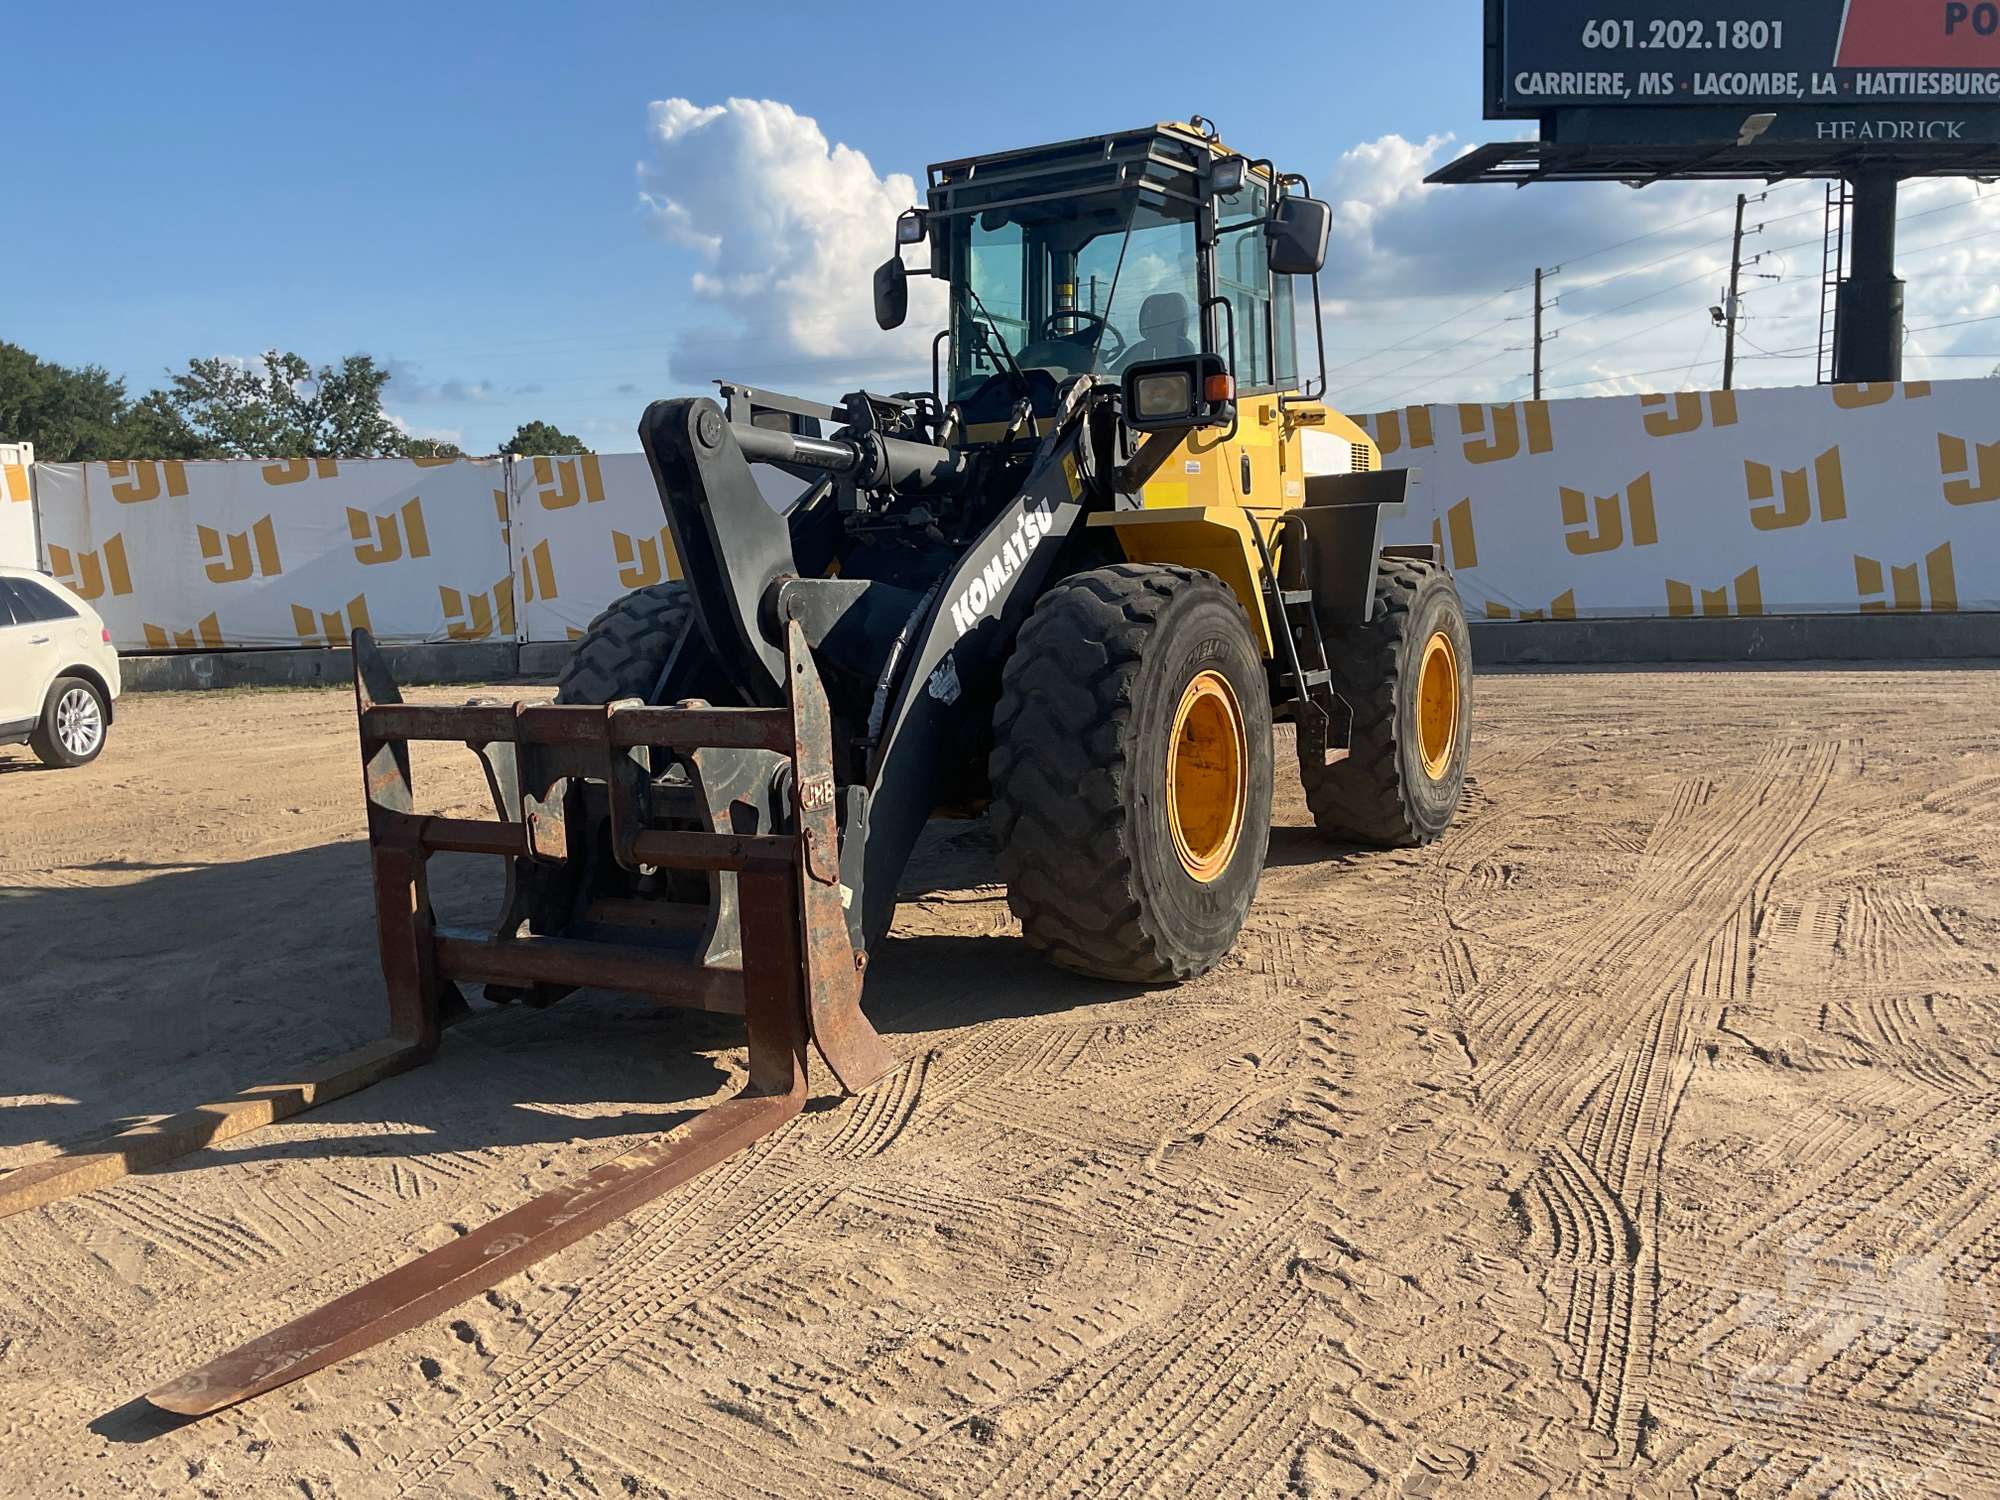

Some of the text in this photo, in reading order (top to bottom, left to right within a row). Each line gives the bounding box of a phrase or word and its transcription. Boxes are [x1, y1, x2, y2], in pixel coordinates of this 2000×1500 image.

[1582, 19, 1784, 49] 601.202.1801
[1515, 72, 1632, 98] CARRIERE,
[1638, 72, 1674, 95] MS
[1694, 72, 1805, 98] LACOMBE,
[1811, 72, 1837, 95] LA
[1816, 121, 1966, 139] HEADRICK
[951, 497, 1053, 638] KOMATSU
